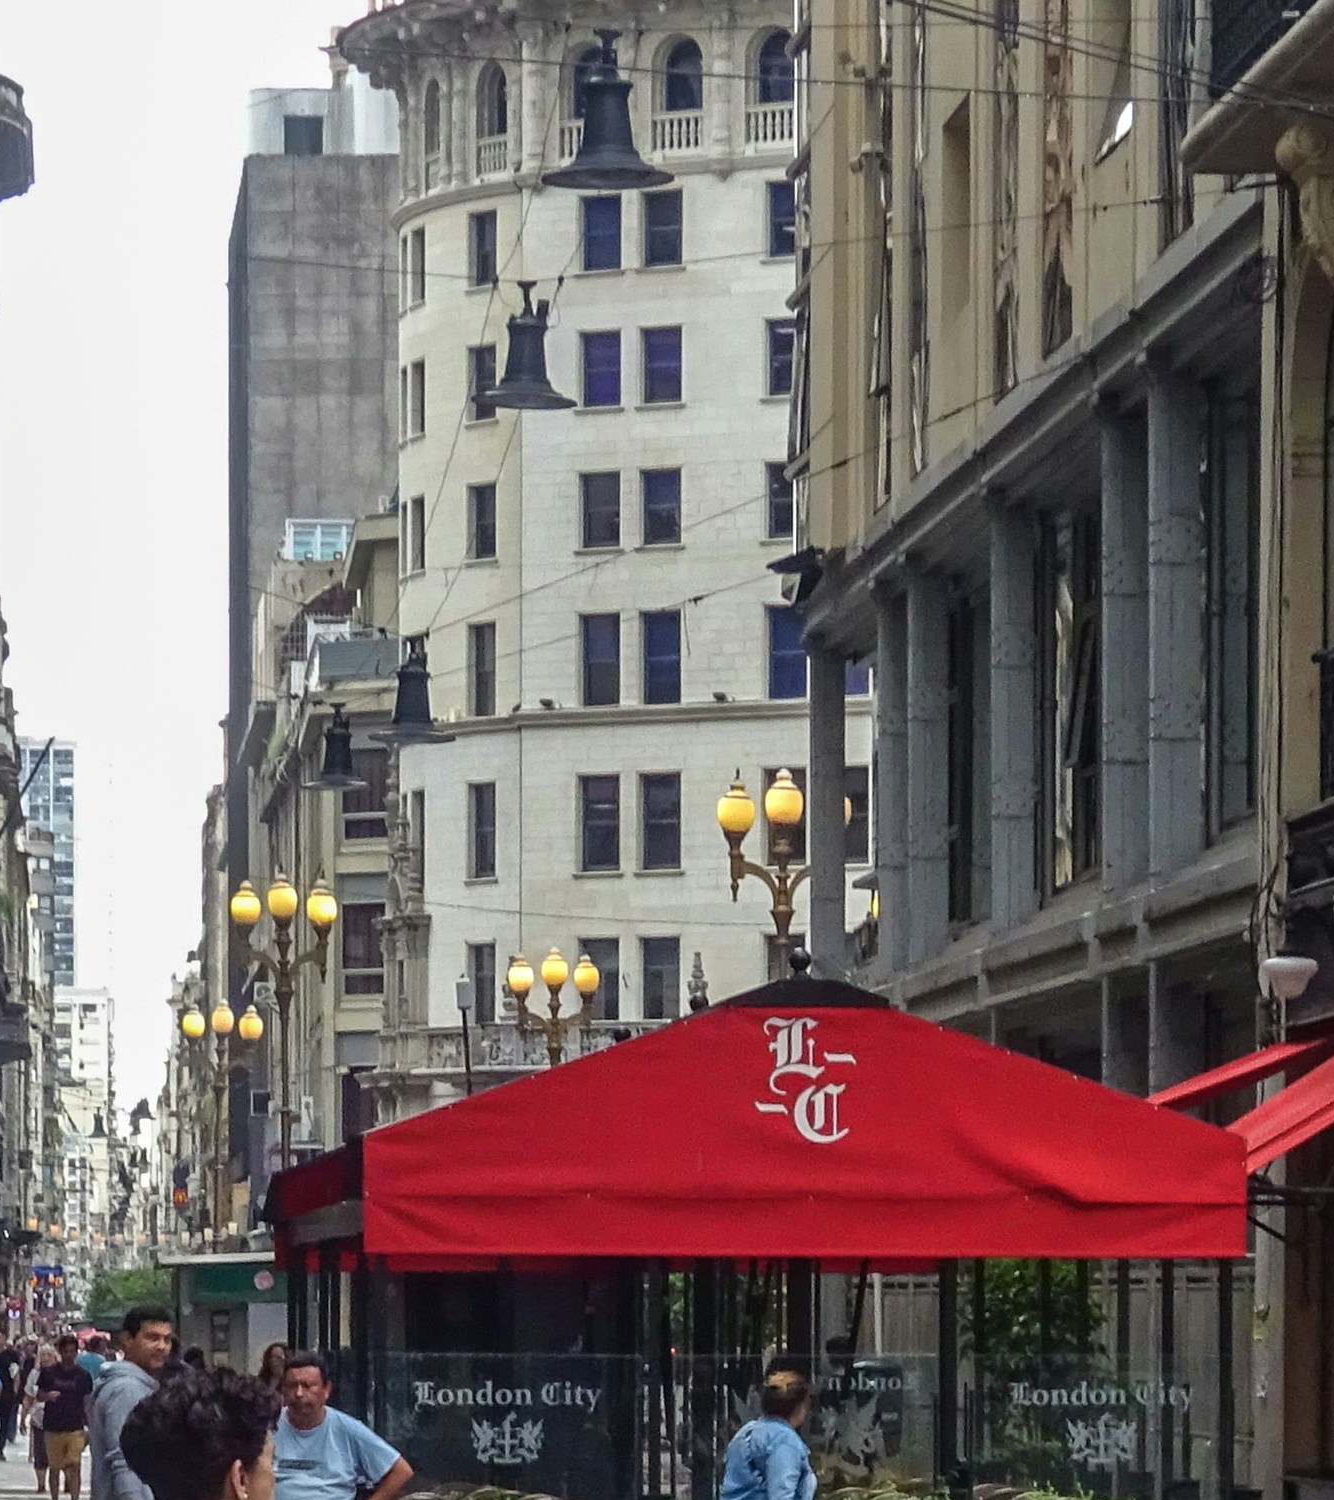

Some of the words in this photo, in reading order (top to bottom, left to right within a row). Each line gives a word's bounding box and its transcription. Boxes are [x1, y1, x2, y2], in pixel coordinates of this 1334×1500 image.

[413, 1379, 533, 1412] London
[540, 1380, 603, 1414] City
[1009, 1380, 1127, 1412] London
[1135, 1380, 1192, 1413] City
